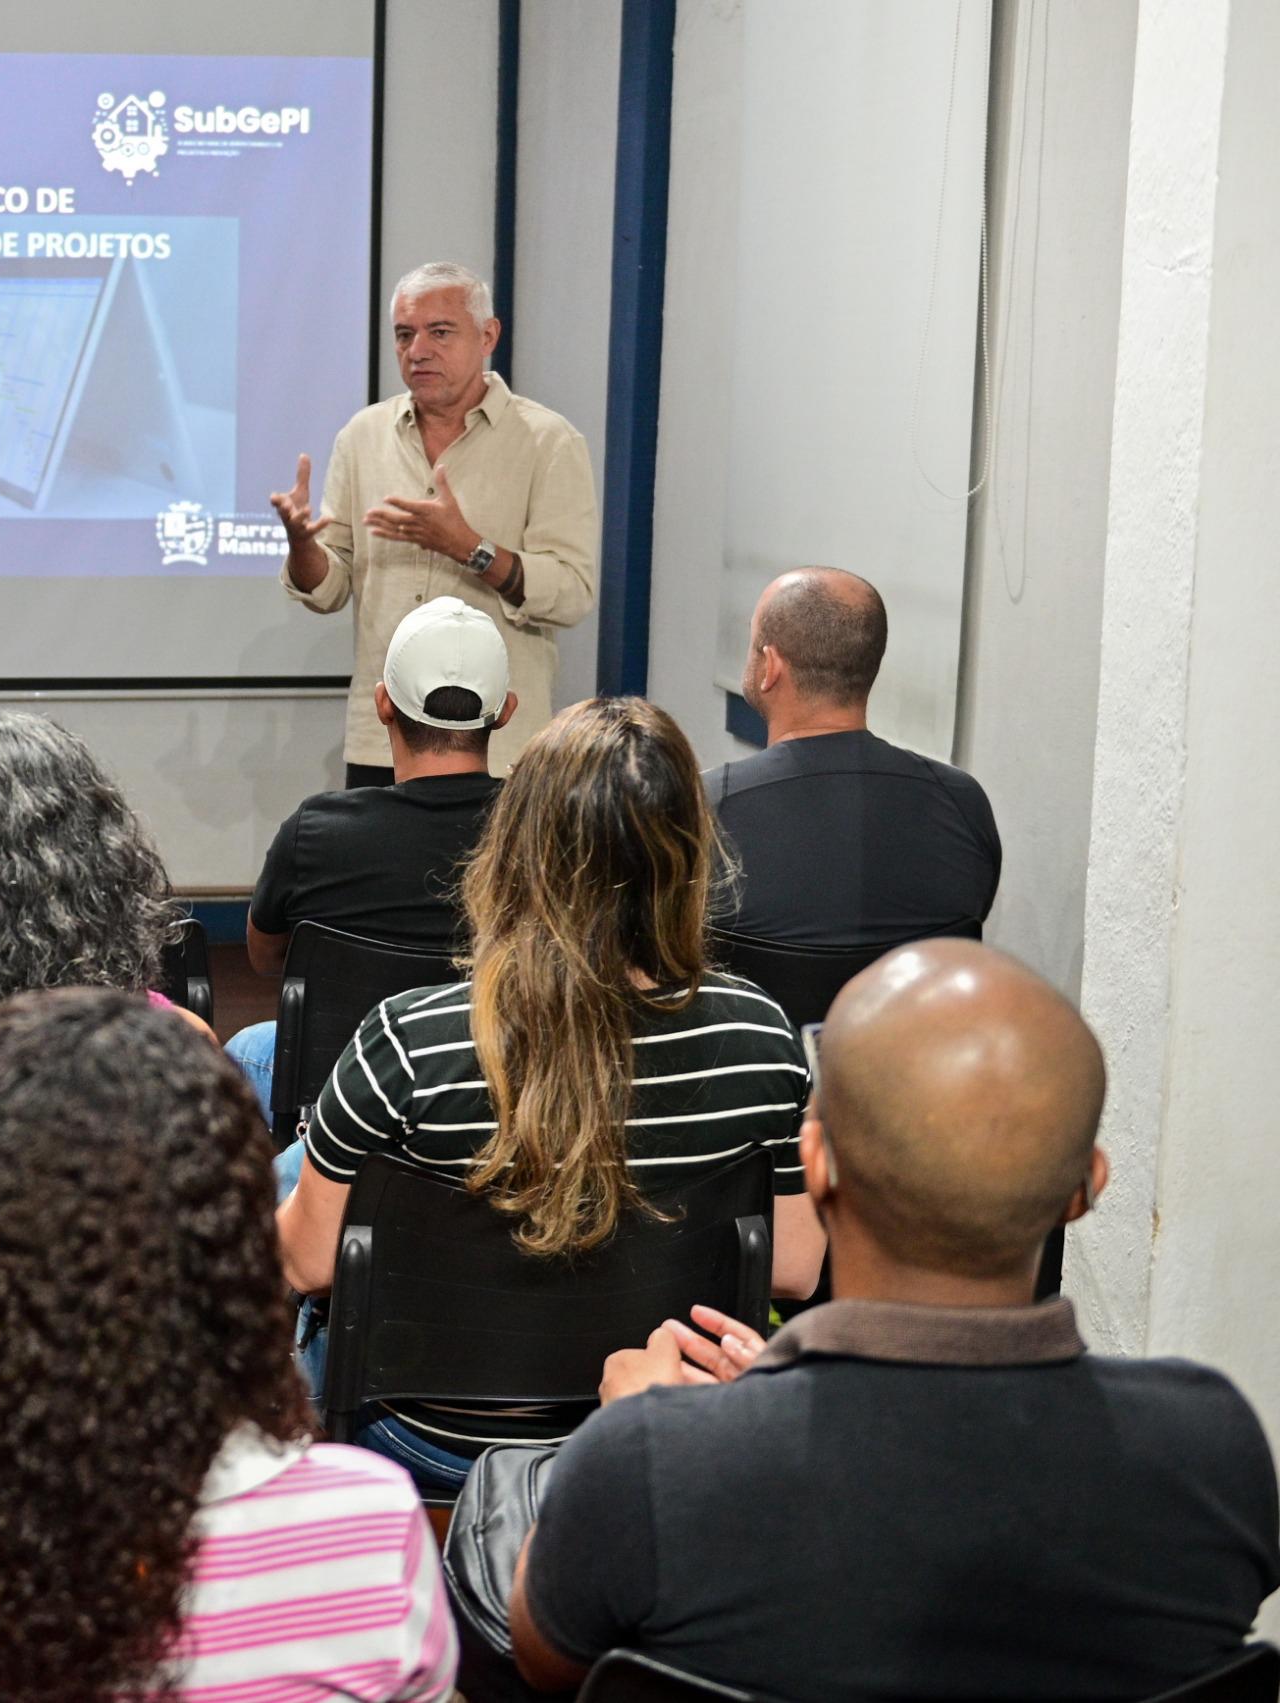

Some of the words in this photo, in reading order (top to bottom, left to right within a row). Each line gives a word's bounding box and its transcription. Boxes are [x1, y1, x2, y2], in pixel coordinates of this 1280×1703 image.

[173, 105, 310, 134] SubGePI
[36, 187, 75, 214] DE
[27, 232, 172, 259] PROJETOS
[218, 521, 288, 538] Barra
[218, 538, 290, 556] Mansa
